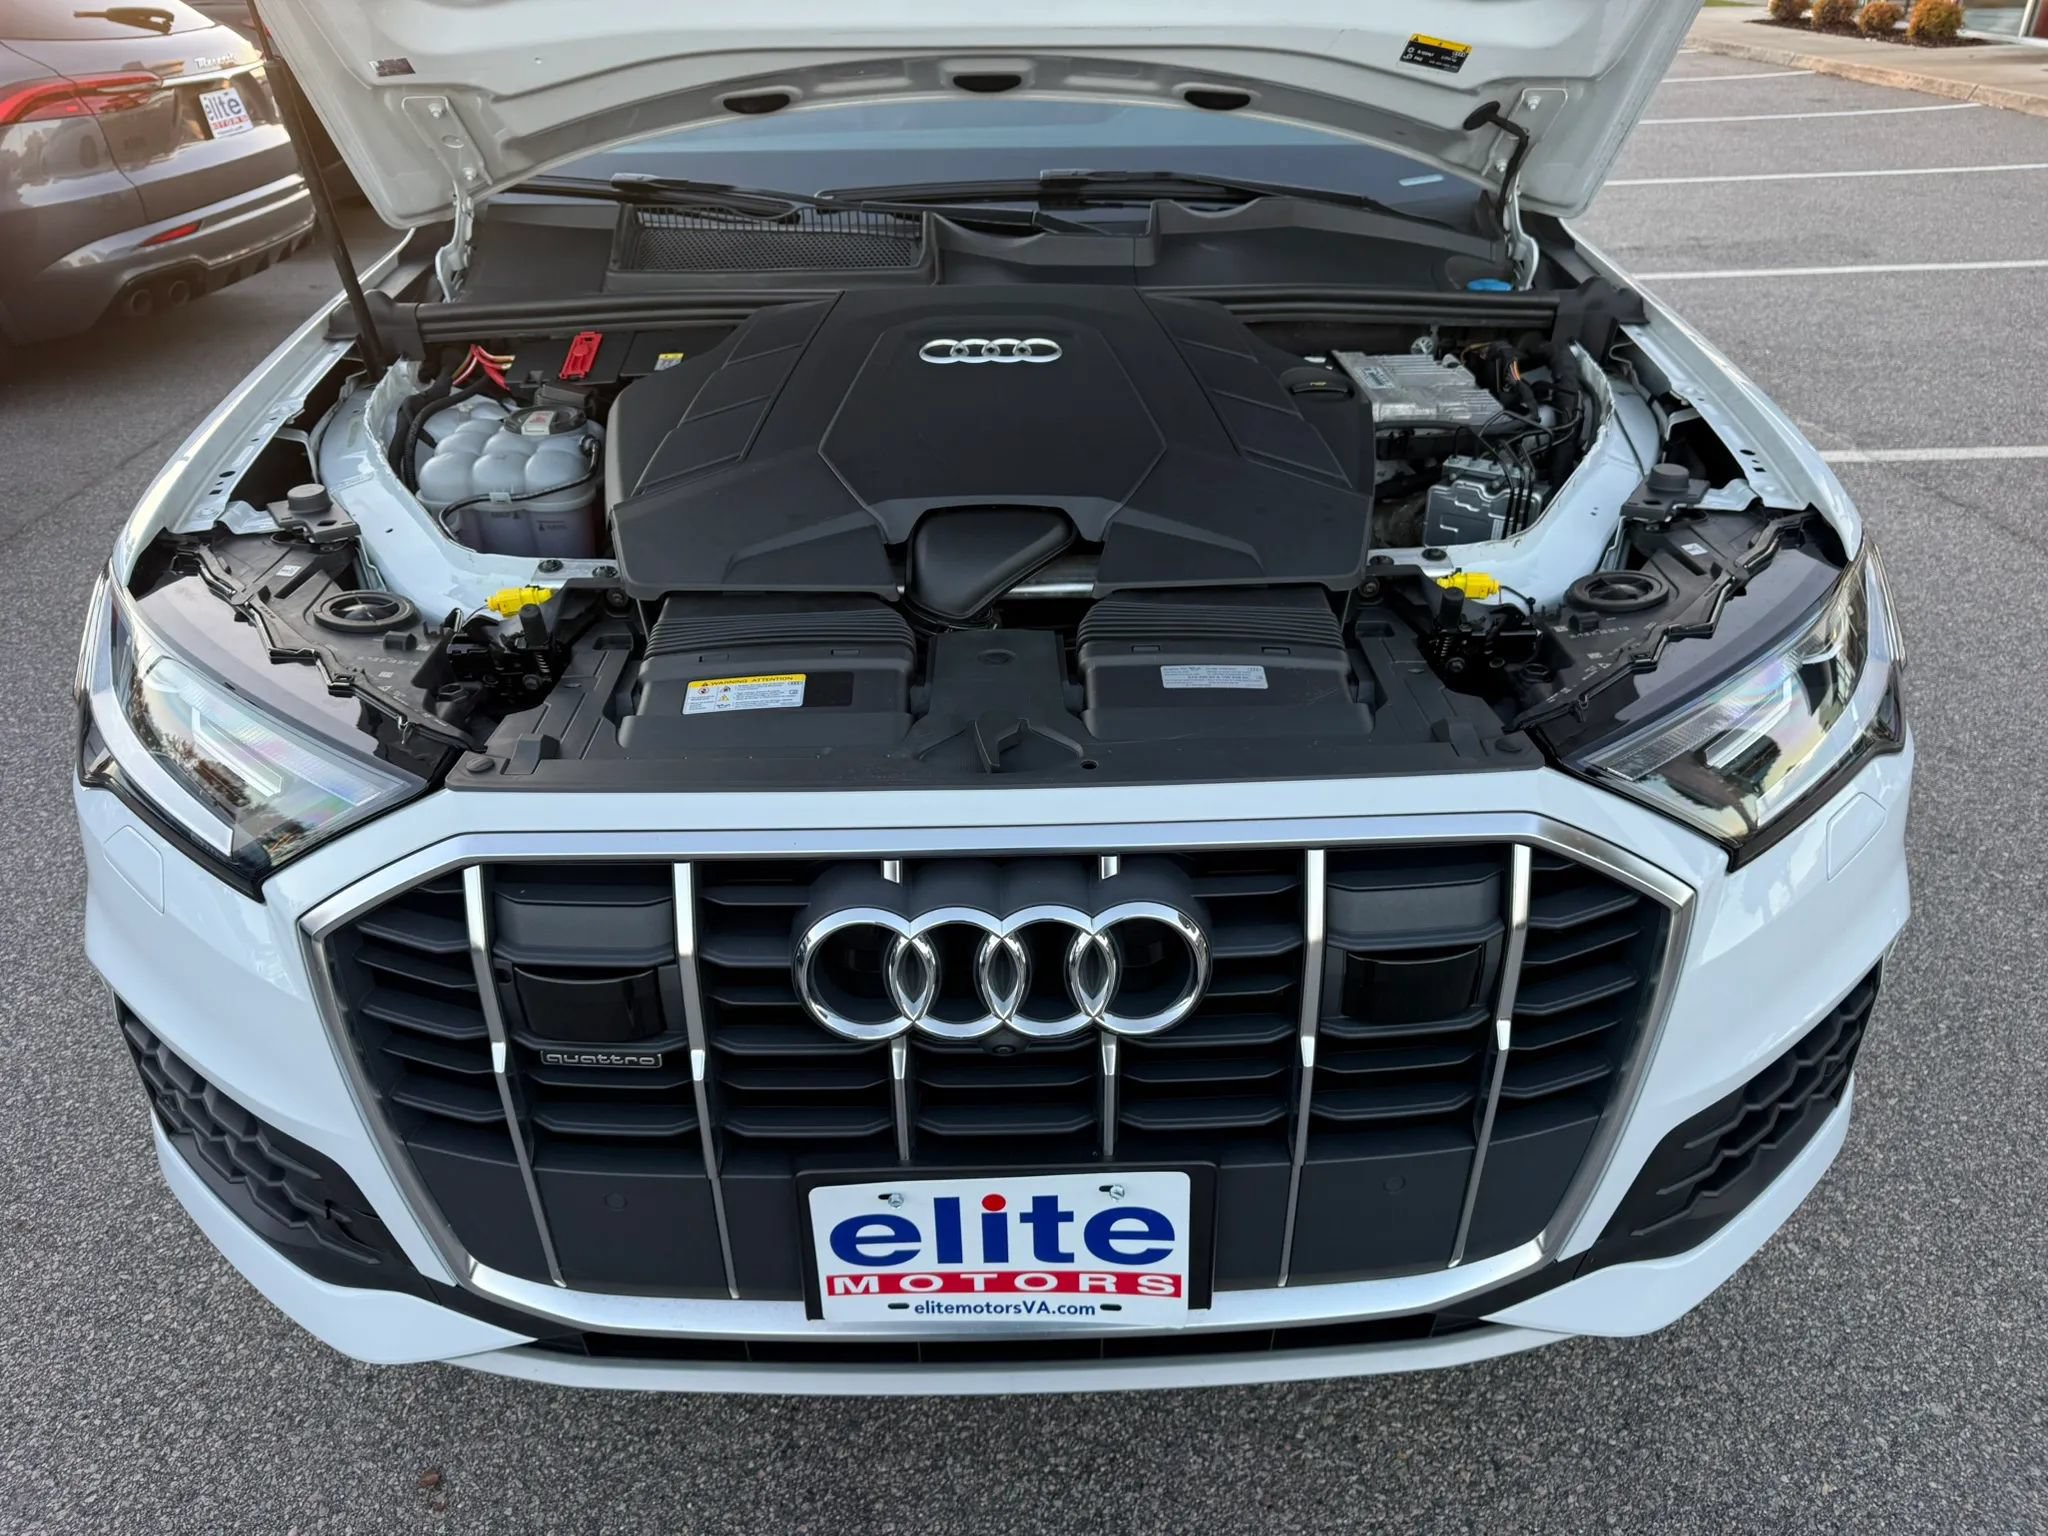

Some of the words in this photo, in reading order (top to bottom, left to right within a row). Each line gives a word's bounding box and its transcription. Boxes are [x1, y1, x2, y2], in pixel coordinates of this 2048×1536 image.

[205, 96, 242, 121] elite
[711, 679, 748, 687] WARNING
[751, 676, 794, 684] ATTENTION
[546, 1053, 655, 1064] quattro
[829, 1194, 1176, 1267] elite
[833, 1272, 1175, 1297] MOTORS
[914, 1299, 1096, 1317] elitemotorsVA.com
